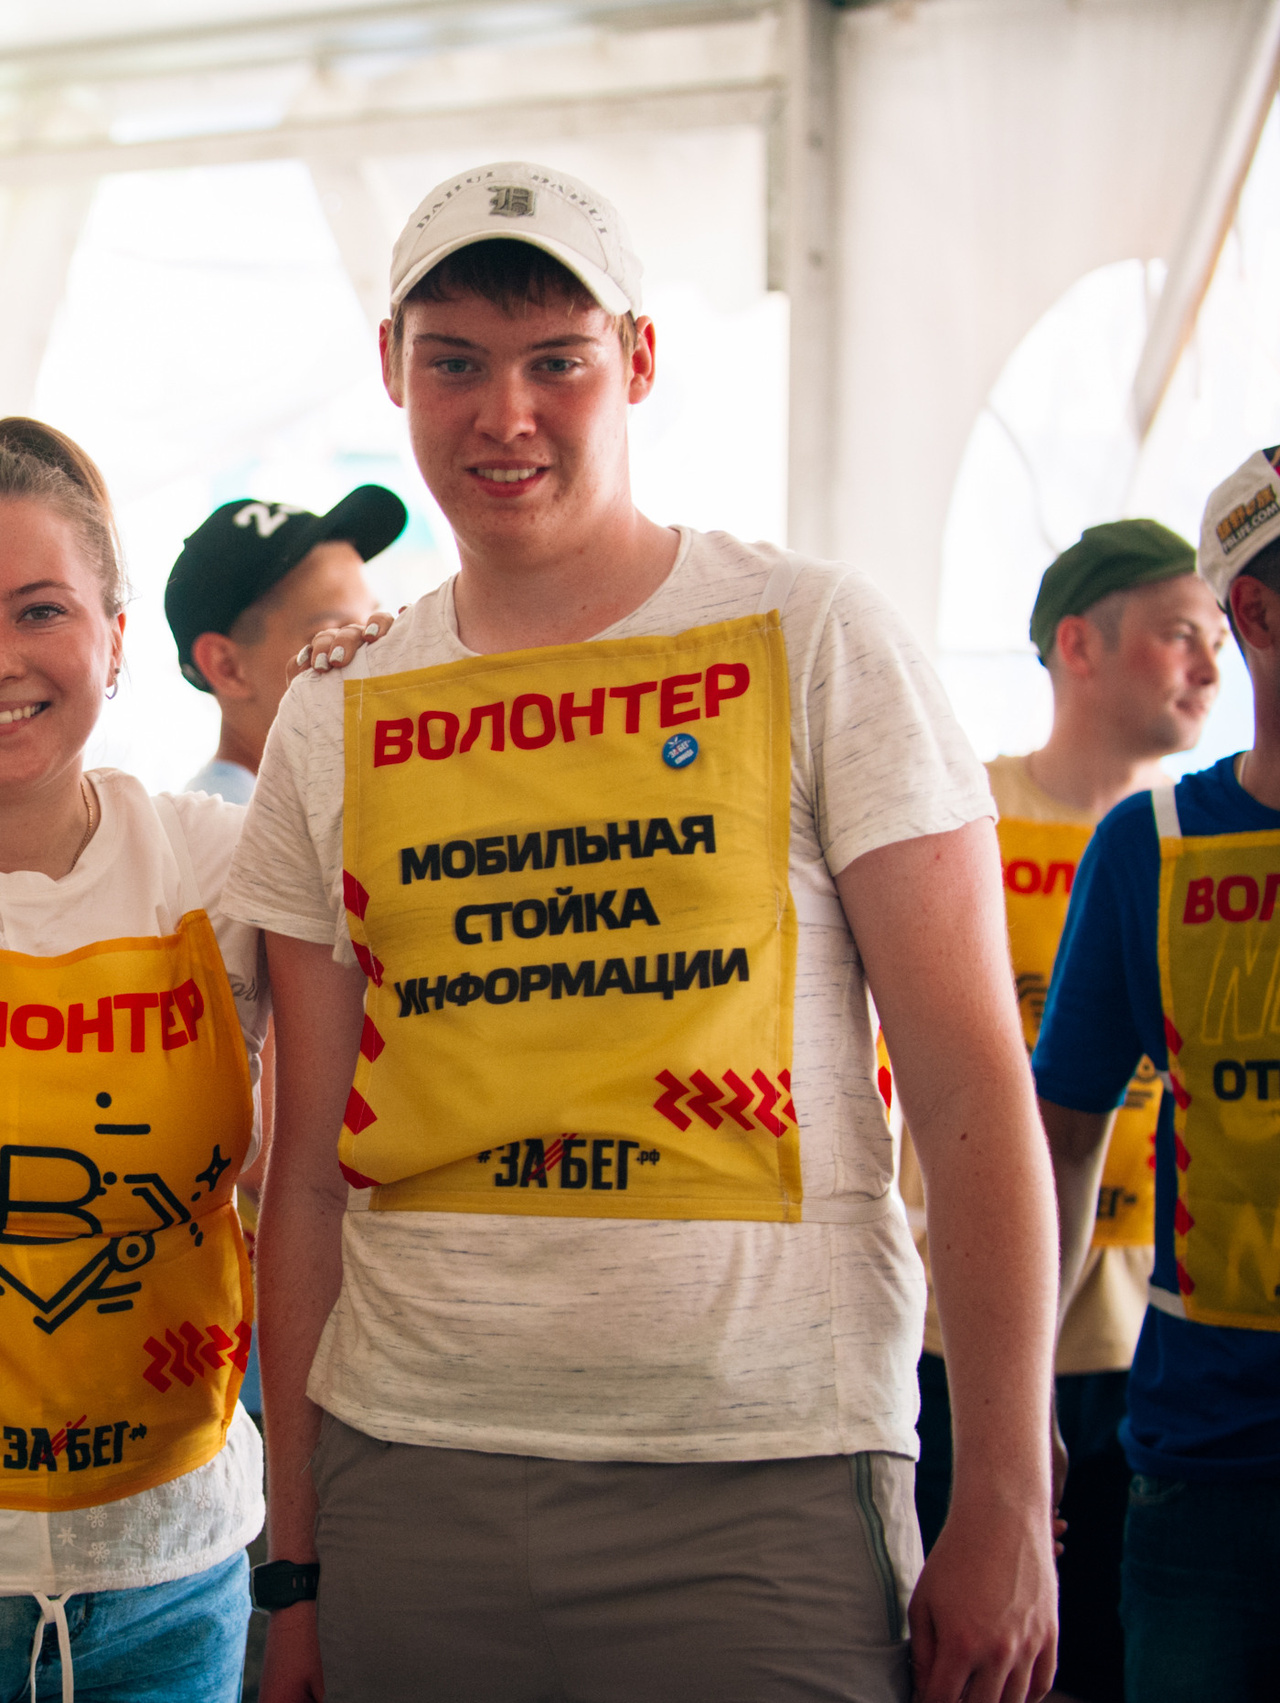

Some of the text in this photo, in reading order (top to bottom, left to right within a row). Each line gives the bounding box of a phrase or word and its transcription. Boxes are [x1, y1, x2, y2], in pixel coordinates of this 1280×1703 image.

[374, 662, 751, 768] ВОЛОНТЕР
[399, 815, 717, 885] МОБИЛЬНАЯ
[454, 886, 660, 945] СТОЙКА
[394, 947, 750, 1018] ИНФОРМАЦИИ
[1213, 1060, 1280, 1102] ОТ
